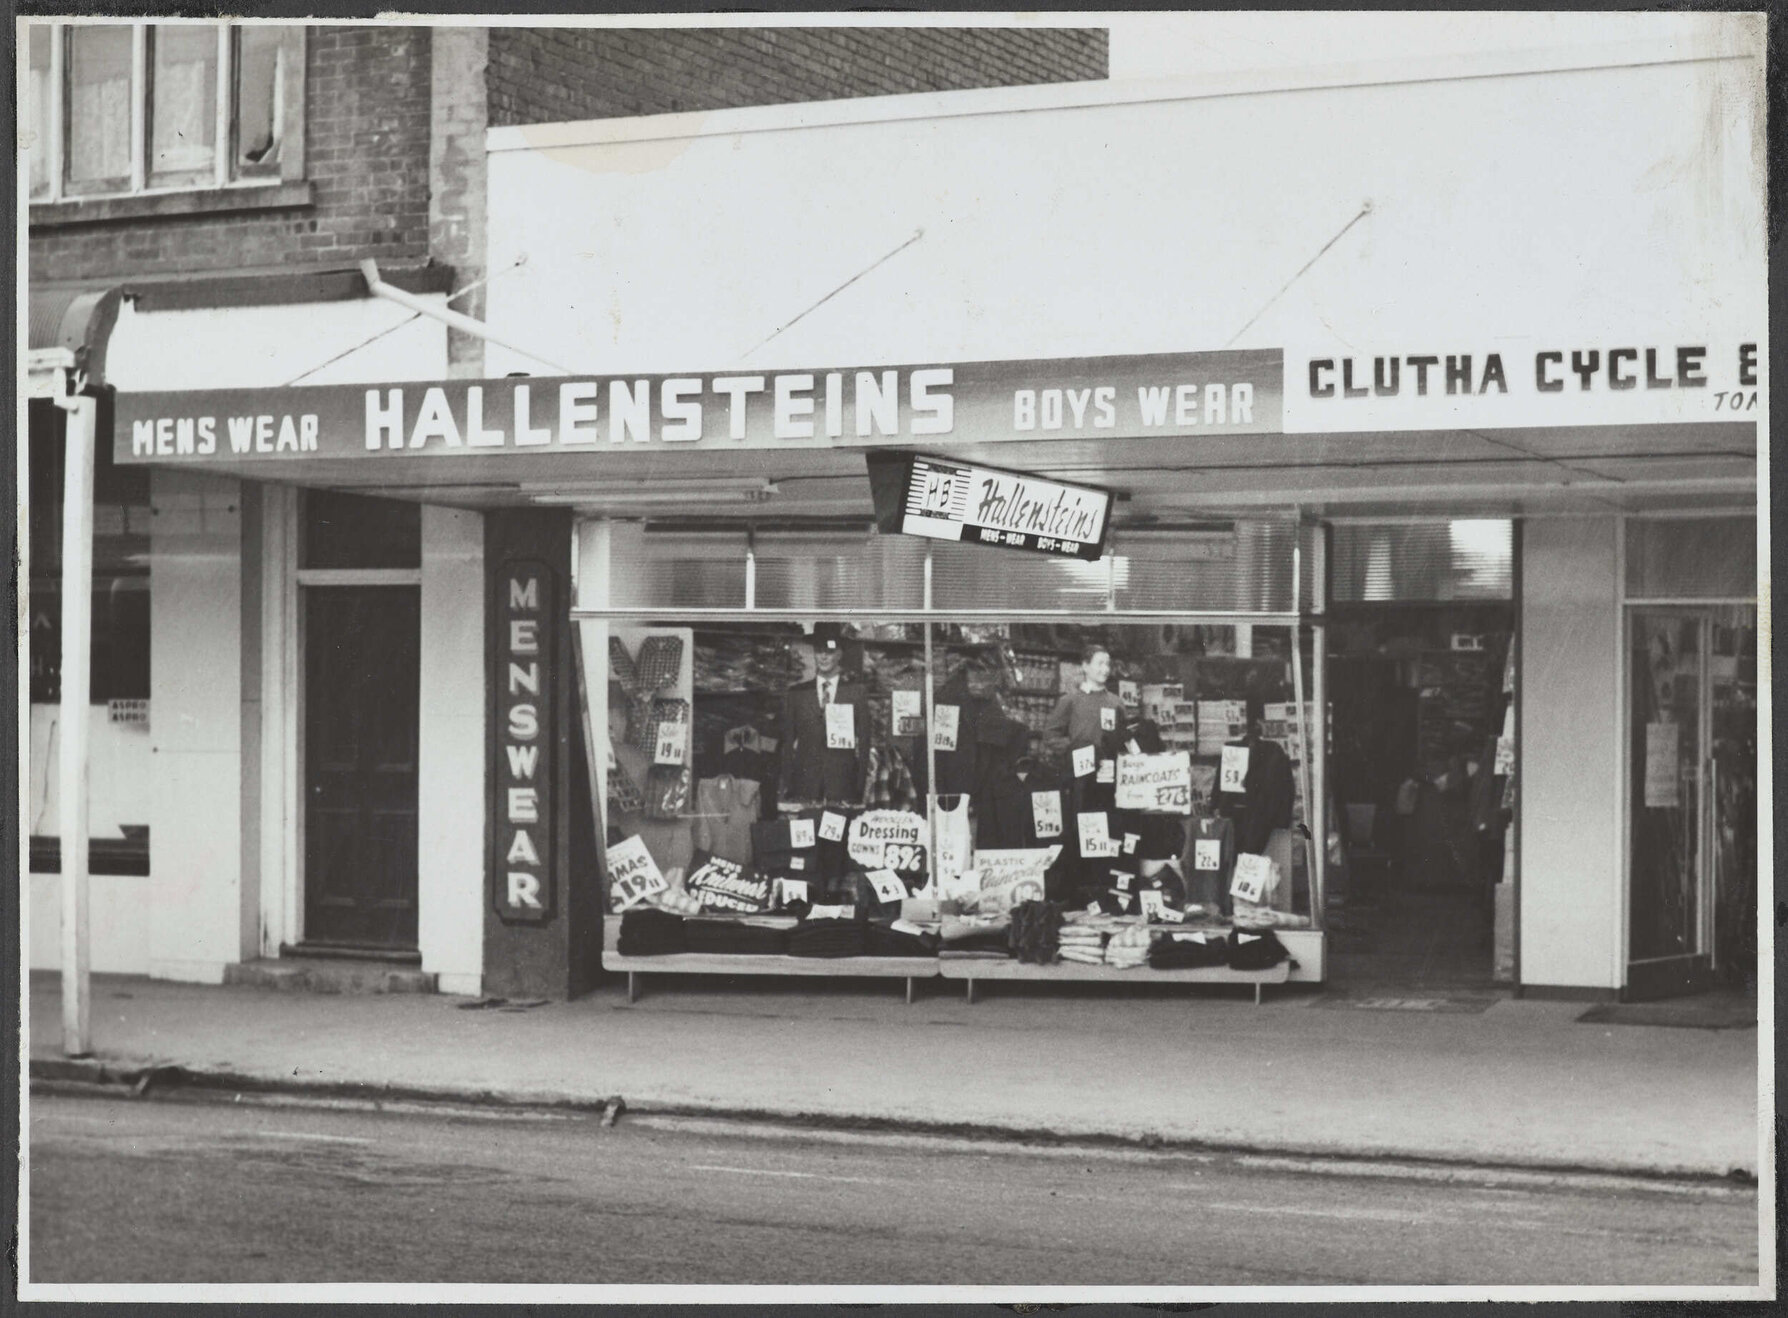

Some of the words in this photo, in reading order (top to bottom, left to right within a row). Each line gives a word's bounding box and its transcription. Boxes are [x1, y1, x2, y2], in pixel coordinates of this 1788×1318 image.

[1308, 352, 1509, 399] CLUTHA
[1535, 345, 1708, 394] CYCLE
[365, 368, 955, 451] HALLENSTEINS
[1014, 386, 1116, 431] BOYS
[1138, 382, 1254, 427] WEAR
[132, 416, 216, 456] MENS
[227, 413, 319, 454] WEAR
[976, 477, 1099, 541] Hallensteins
[505, 577, 544, 910] MENSWEAR
[859, 821, 919, 844] Dressing
[979, 857, 1025, 867] PLASTIC
[619, 873, 648, 901] 19
